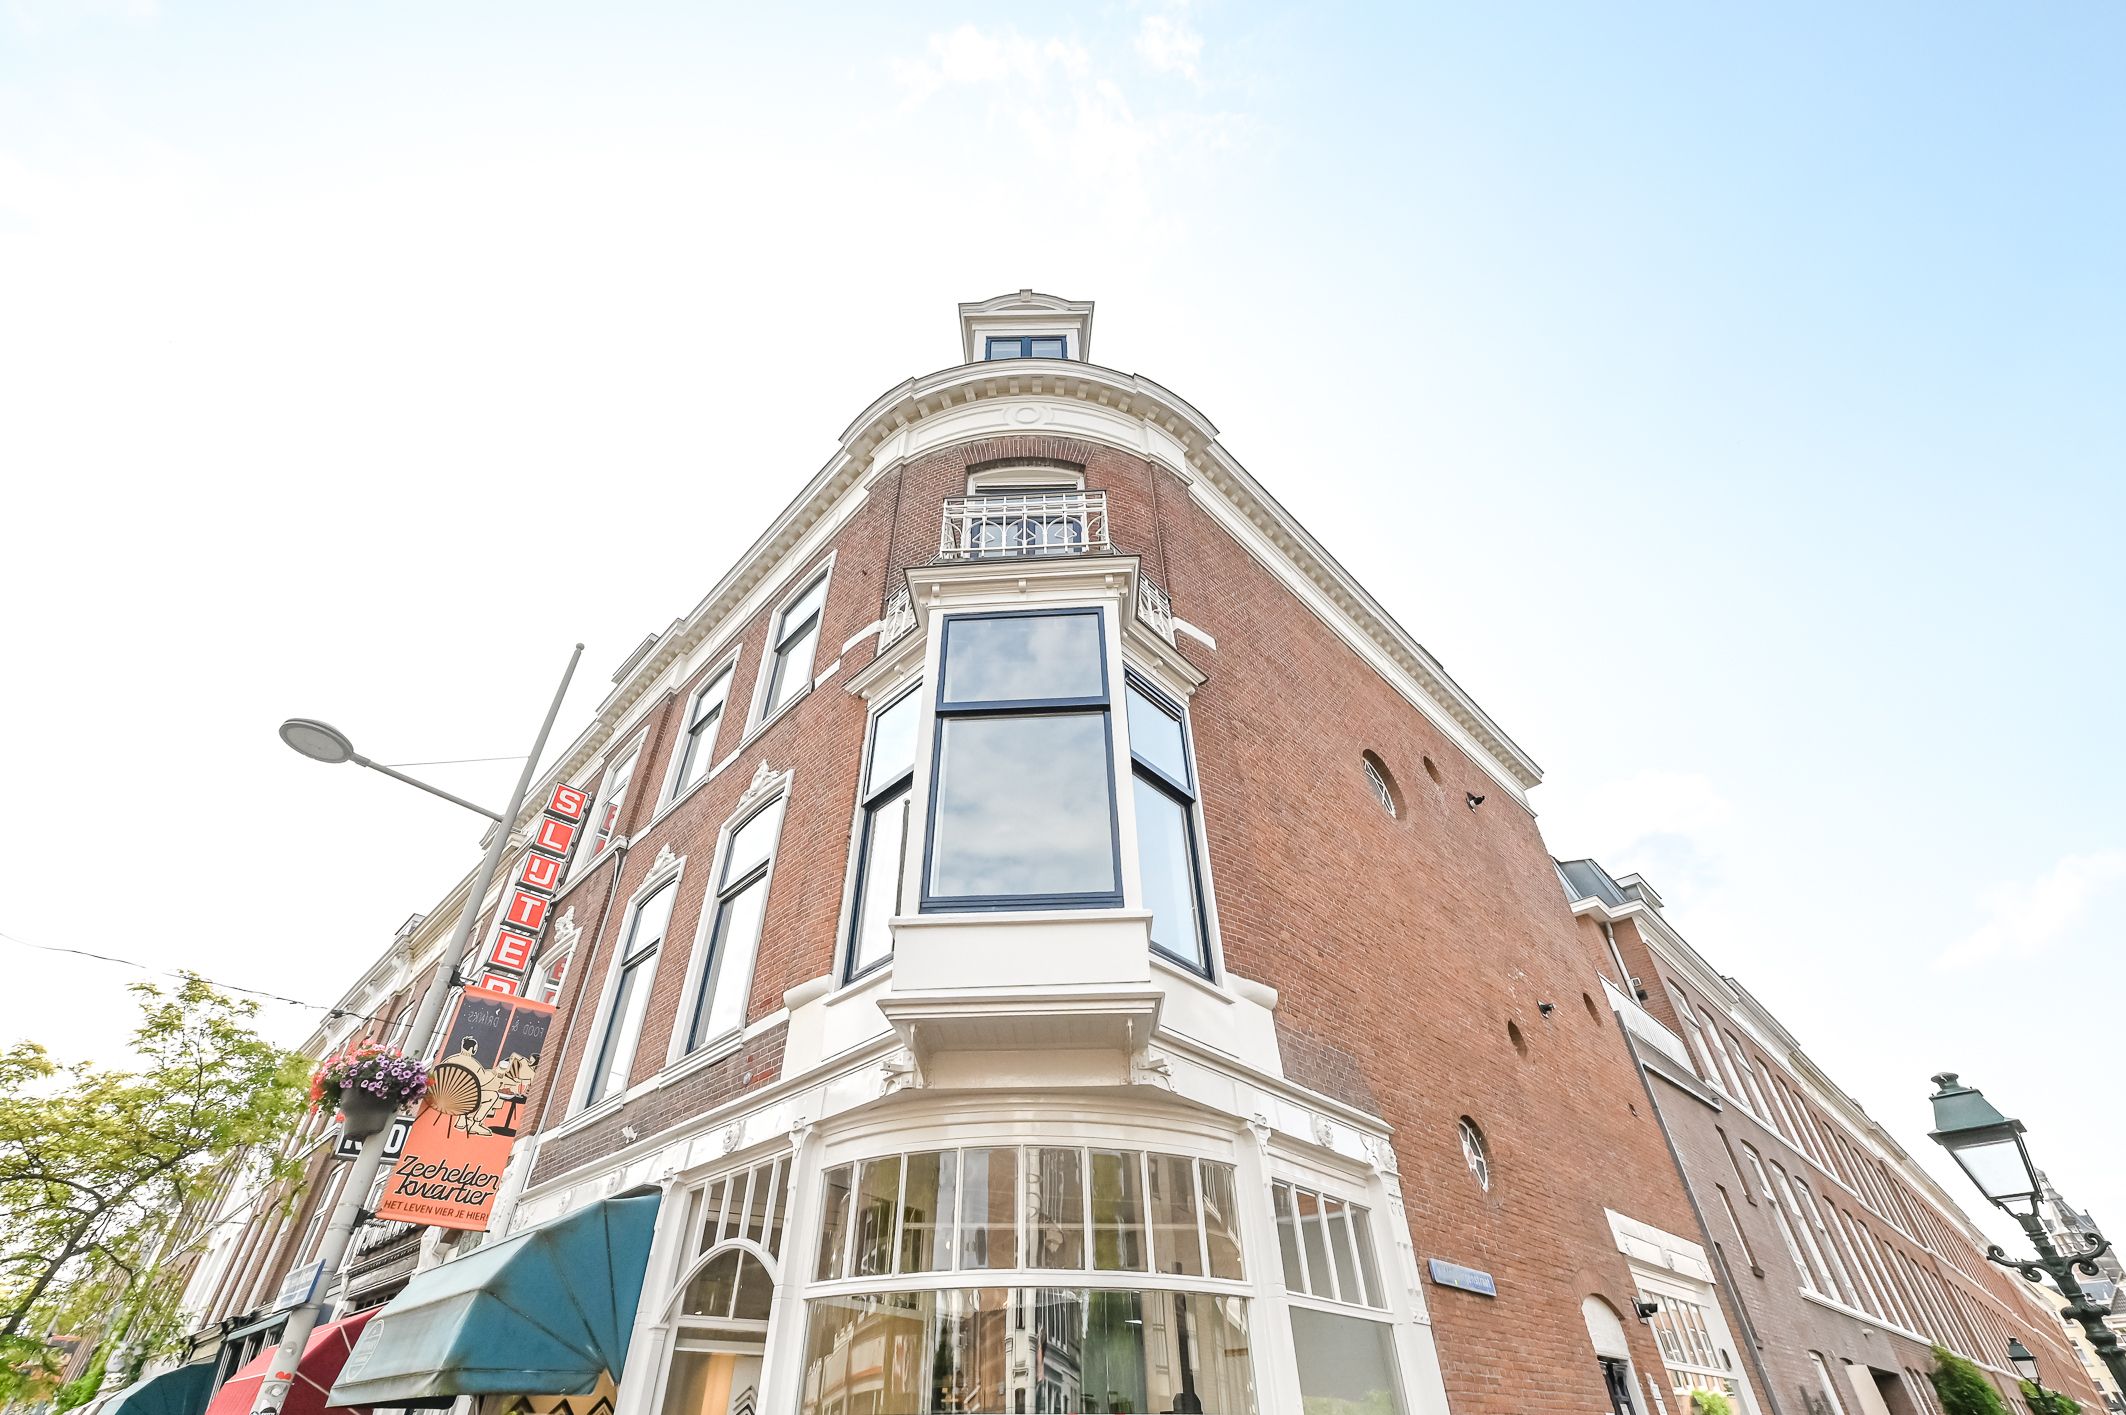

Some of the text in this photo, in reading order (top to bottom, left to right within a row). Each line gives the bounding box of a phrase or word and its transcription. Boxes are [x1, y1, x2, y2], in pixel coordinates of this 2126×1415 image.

[395, 1155, 500, 1190] Zeehelden
[394, 1175, 494, 1206] kwartier
[384, 1200, 404, 1210] HET
[403, 1202, 433, 1214] LEVEN
[434, 1207, 454, 1217] VIER
[455, 1209, 466, 1219] JE
